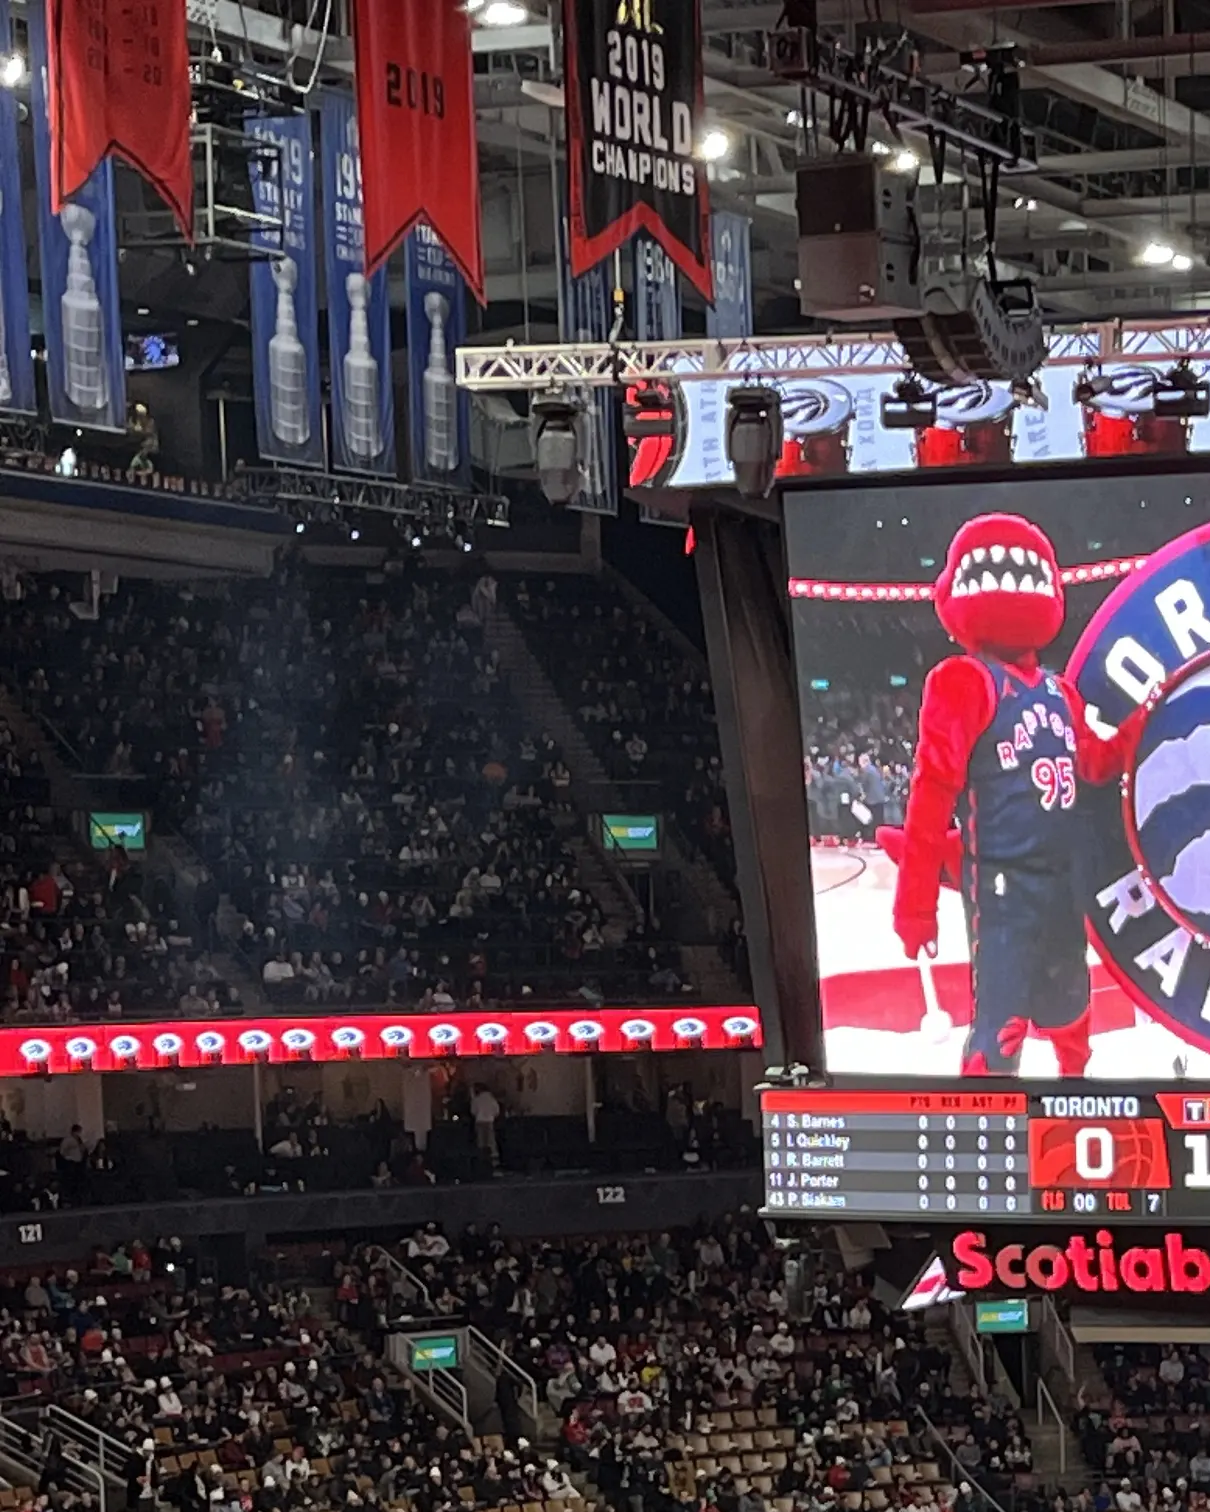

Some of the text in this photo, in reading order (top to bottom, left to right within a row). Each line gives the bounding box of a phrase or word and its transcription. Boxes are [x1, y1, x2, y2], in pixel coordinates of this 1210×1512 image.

[606, 30, 665, 91] 2019
[386, 61, 445, 119] 2019
[591, 77, 693, 157] WORLD
[591, 139, 695, 195] CHAMPIONS
[1030, 756, 1077, 811] 95
[1042, 1096, 1139, 1118] TORONTO
[771, 1113, 780, 1129] 4
[801, 1113, 845, 1129] Barnes
[771, 1132, 780, 1148] 5
[771, 1152, 780, 1168] 9
[1075, 1127, 1114, 1180] 0
[770, 1173, 783, 1188] 11
[801, 1173, 839, 1188] Porter
[595, 1185, 625, 1203] 122
[1073, 1193, 1097, 1212] 00
[1147, 1194, 1160, 1212] 7
[19, 1223, 43, 1242] 121
